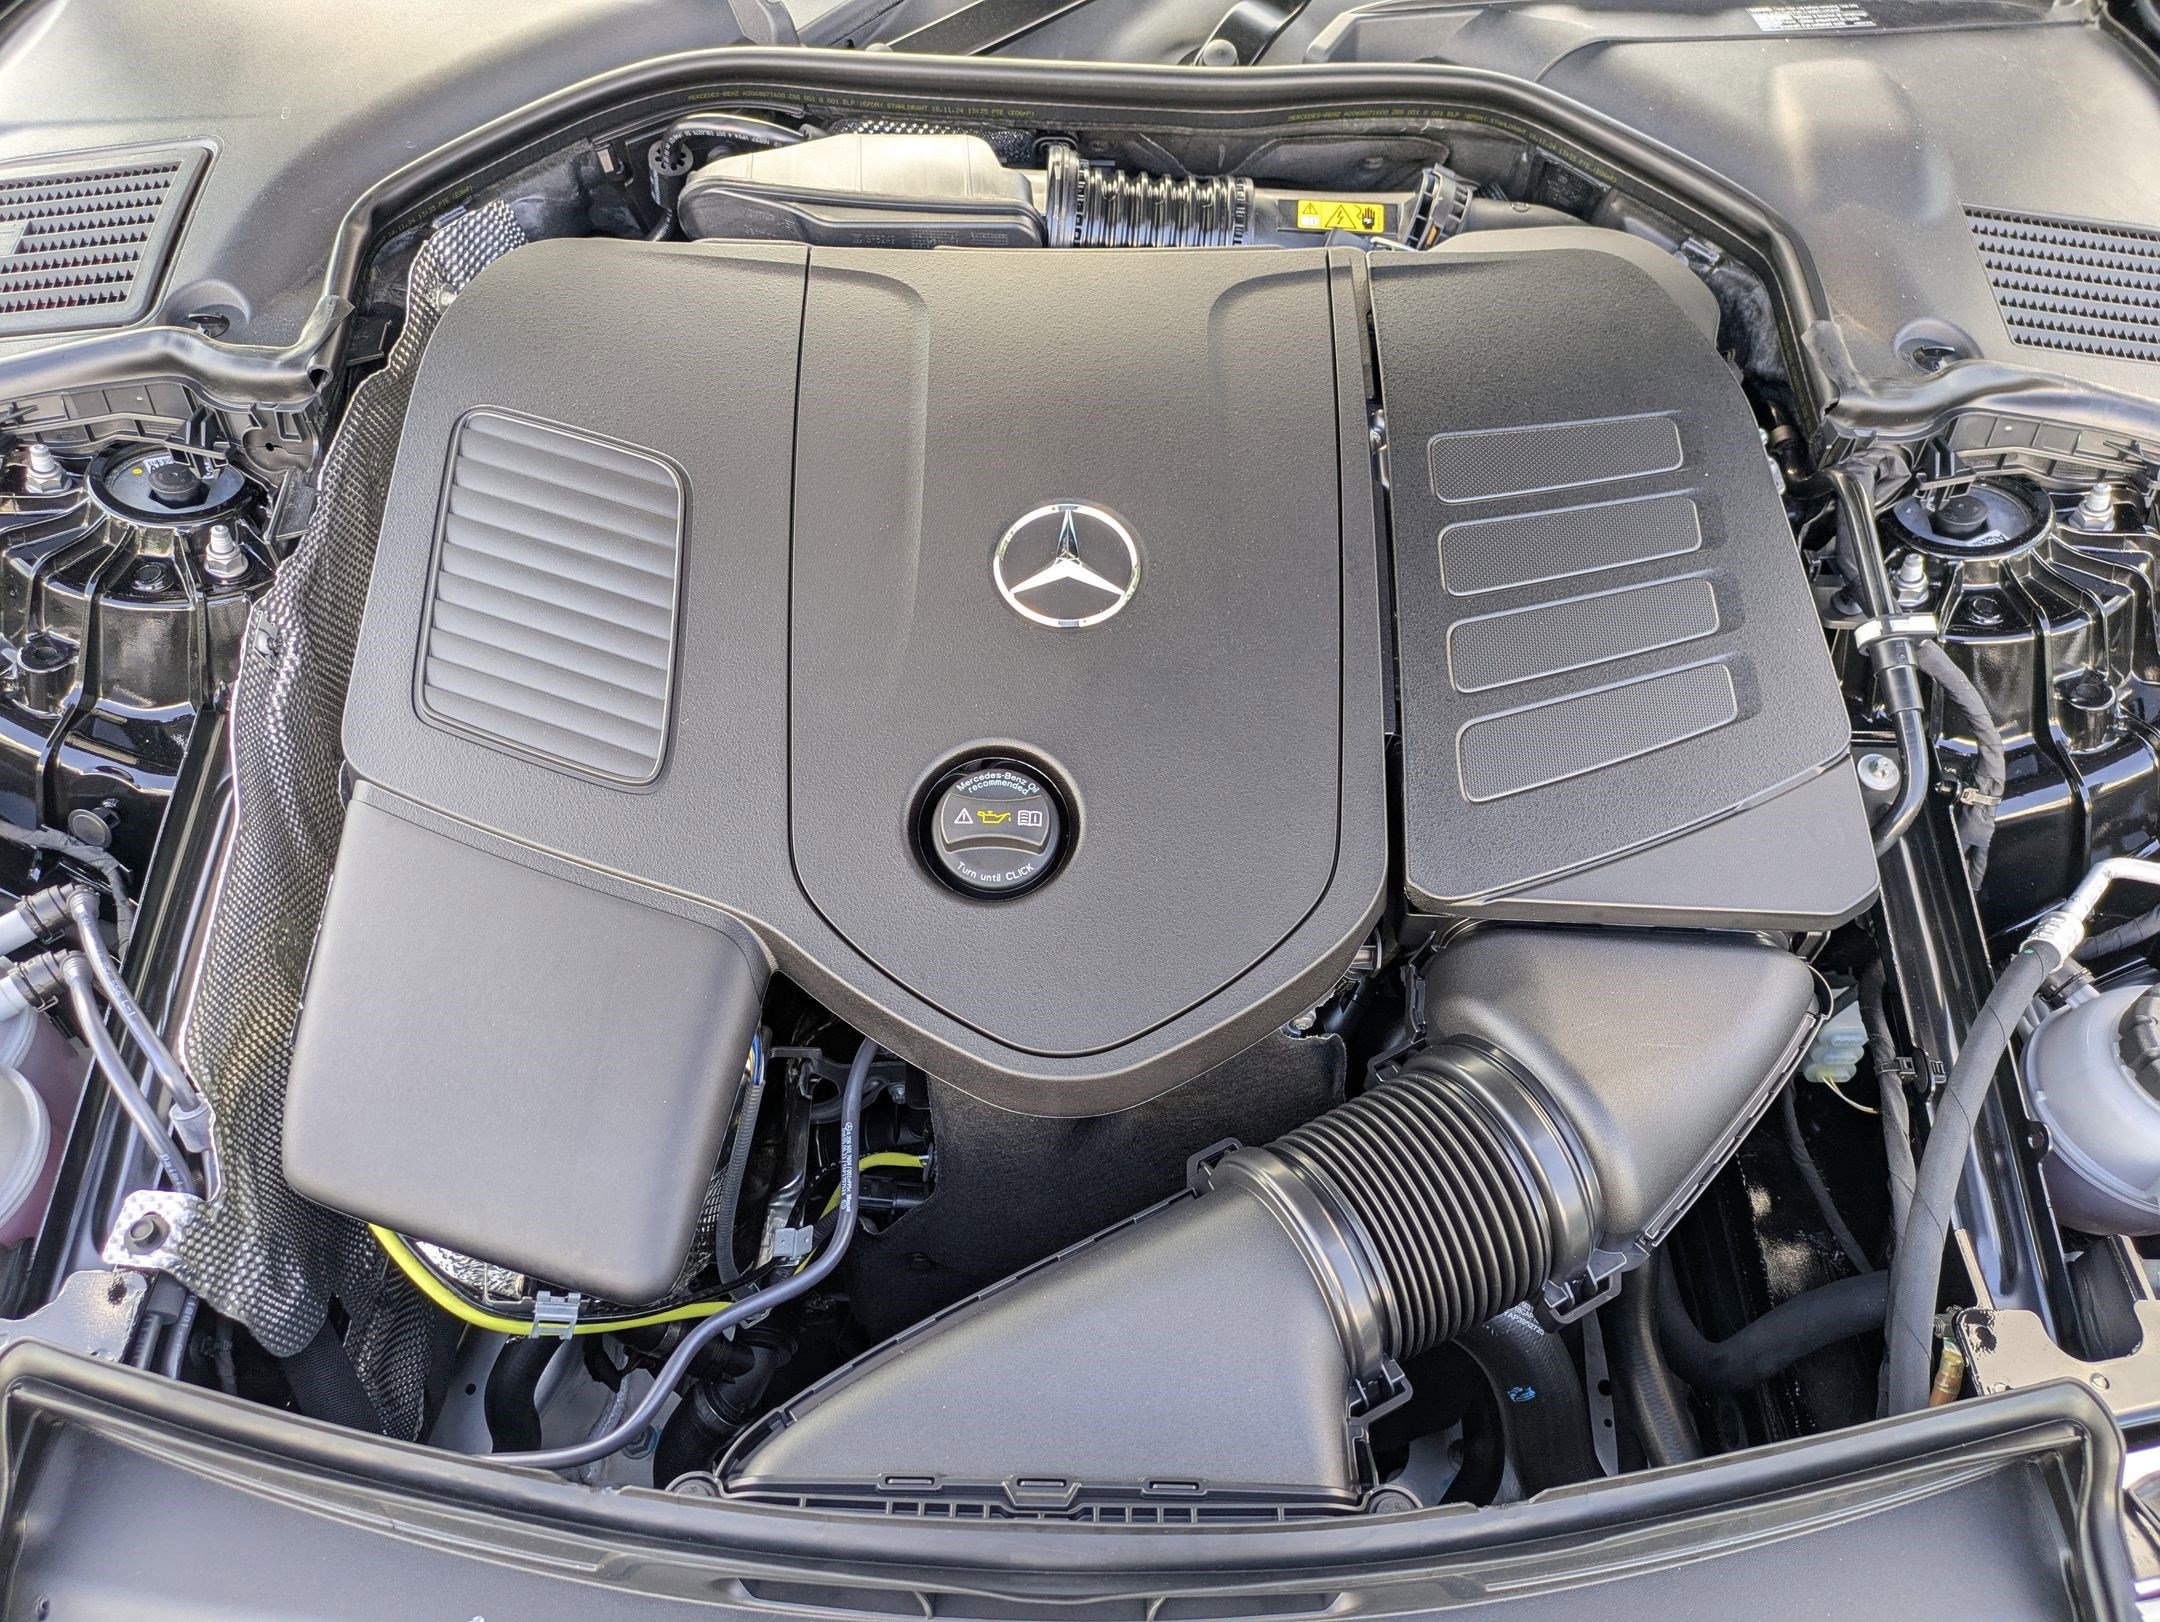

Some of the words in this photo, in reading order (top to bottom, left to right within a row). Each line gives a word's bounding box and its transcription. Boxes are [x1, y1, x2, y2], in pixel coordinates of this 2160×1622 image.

[956, 771, 1027, 792] Mercedes-Benz
[1027, 782, 1041, 794] Oil
[968, 779, 1030, 796] recommended
[956, 861, 978, 878] Turn
[980, 873, 1001, 882] until
[1005, 863, 1035, 881] CLICK
